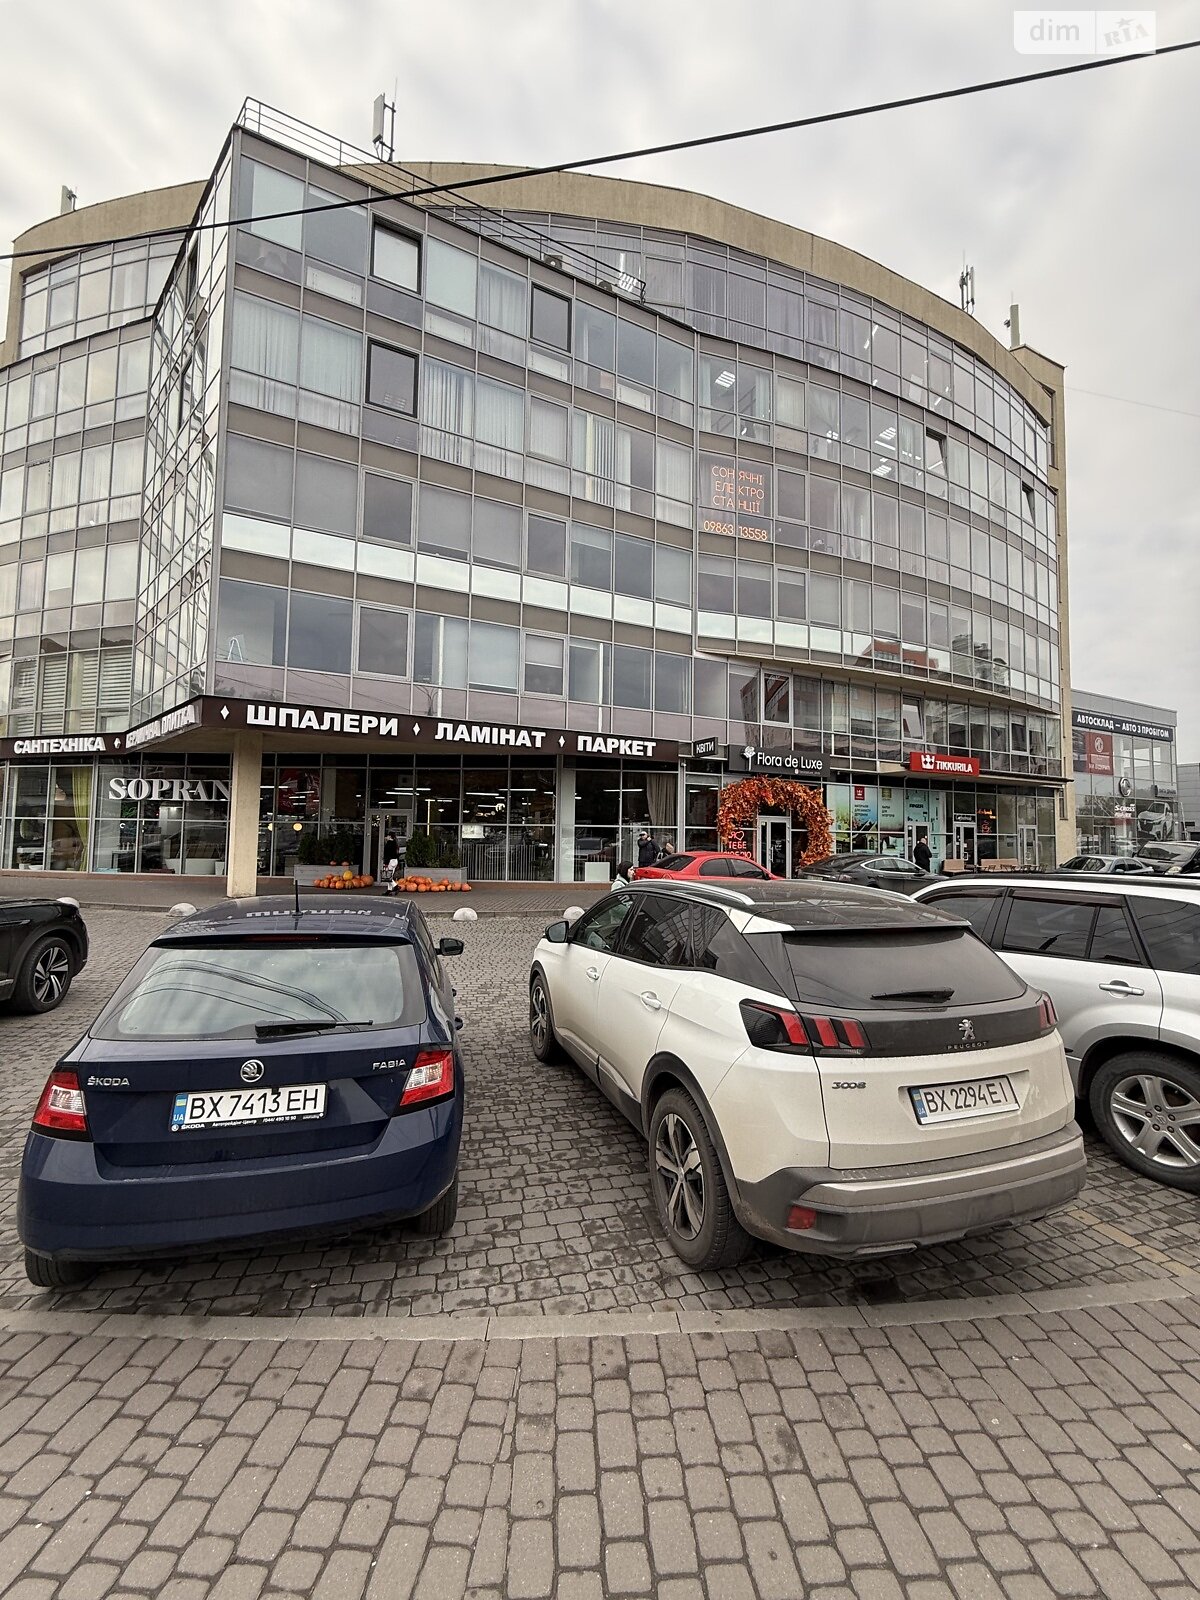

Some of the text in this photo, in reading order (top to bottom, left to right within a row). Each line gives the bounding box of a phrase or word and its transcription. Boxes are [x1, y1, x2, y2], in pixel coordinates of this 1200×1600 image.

[246, 704, 657, 757] ШПАЛЕРИ ЛАМІНАТ ПАРКЕТ
[1077, 714, 1114, 730] АВТОСКЛАД
[1122, 722, 1137, 733] АВТО
[1142, 726, 1170, 739] ПРОБІГОМ
[13, 736, 106, 755] САНТЕХНІКА
[696, 741, 714, 754] КВІТИ
[757, 752, 823, 770] Flora de Luxe
[935, 760, 973, 773] TIKKURILA
[728, 841, 747, 850] ТЕБЕ
[946, 1041, 988, 1051] PEUGEOT
[372, 1059, 407, 1070] FABIA
[87, 1075, 130, 1086] ŠKODA
[831, 1081, 867, 1090] 3008
[950, 1083, 988, 1110] 2294
[229, 1092, 281, 1117] 7413
[173, 1113, 184, 1122] UA
